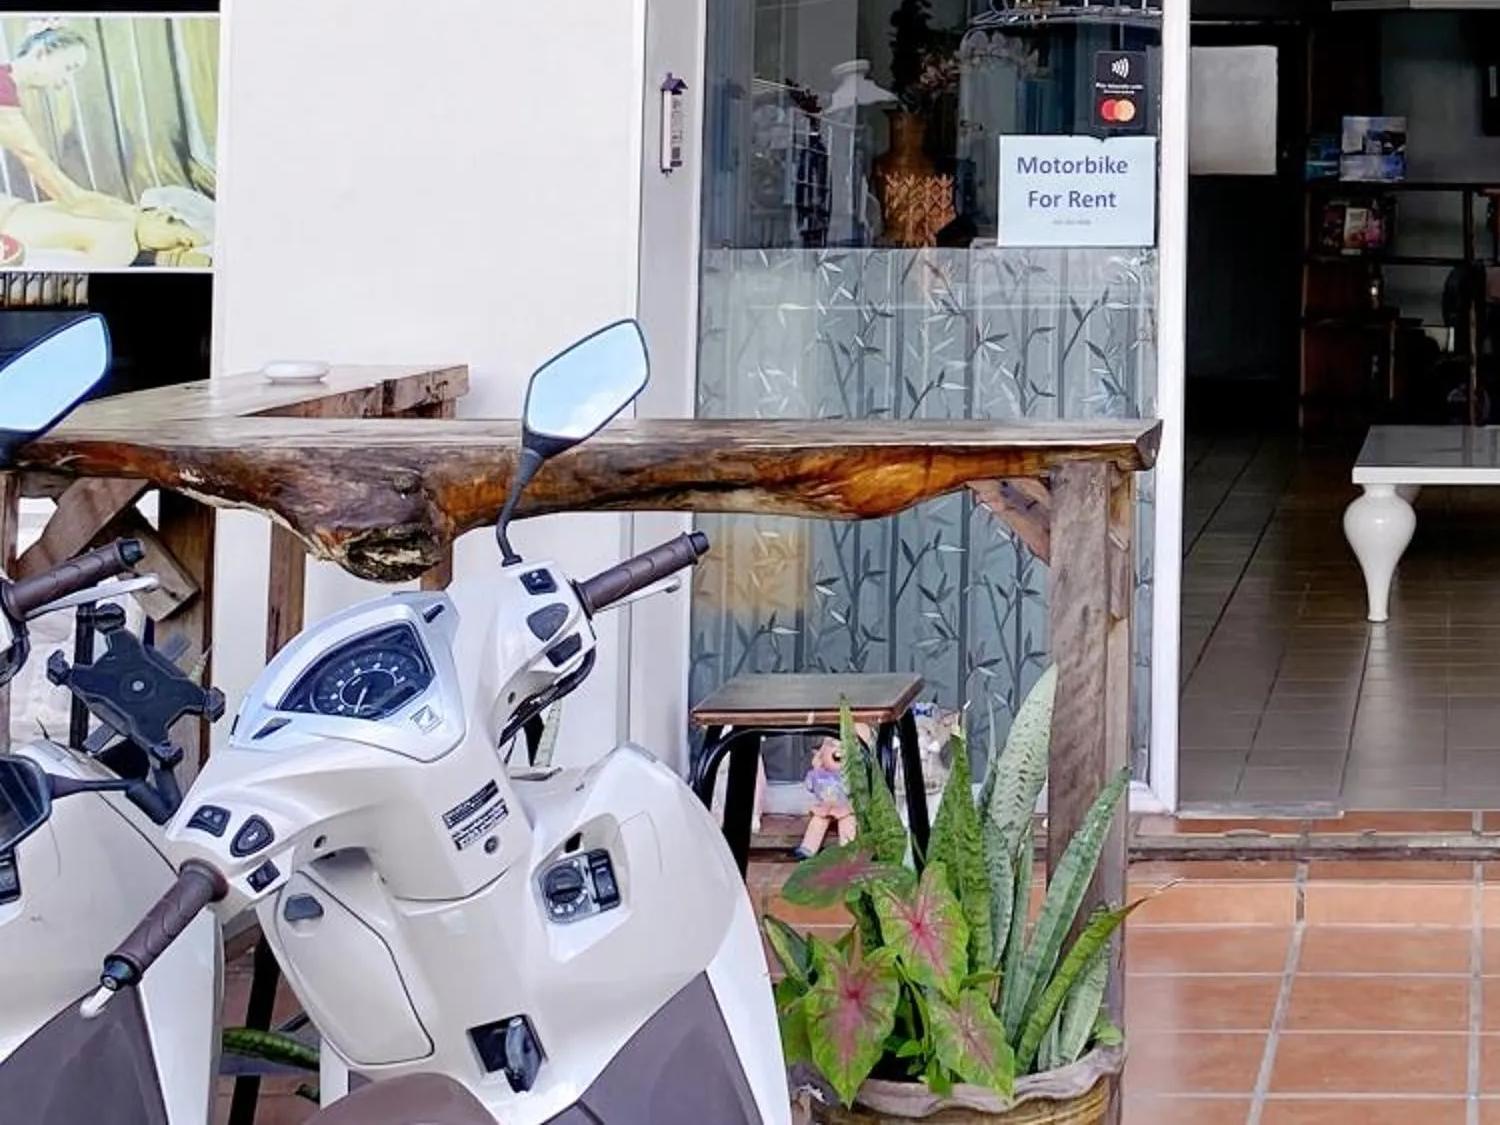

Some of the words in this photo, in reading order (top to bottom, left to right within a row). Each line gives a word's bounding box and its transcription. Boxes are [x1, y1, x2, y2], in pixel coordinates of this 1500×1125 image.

[1017, 156, 1129, 174] Motorbike
[1028, 190, 1062, 208] For
[1069, 190, 1117, 208] Rent
